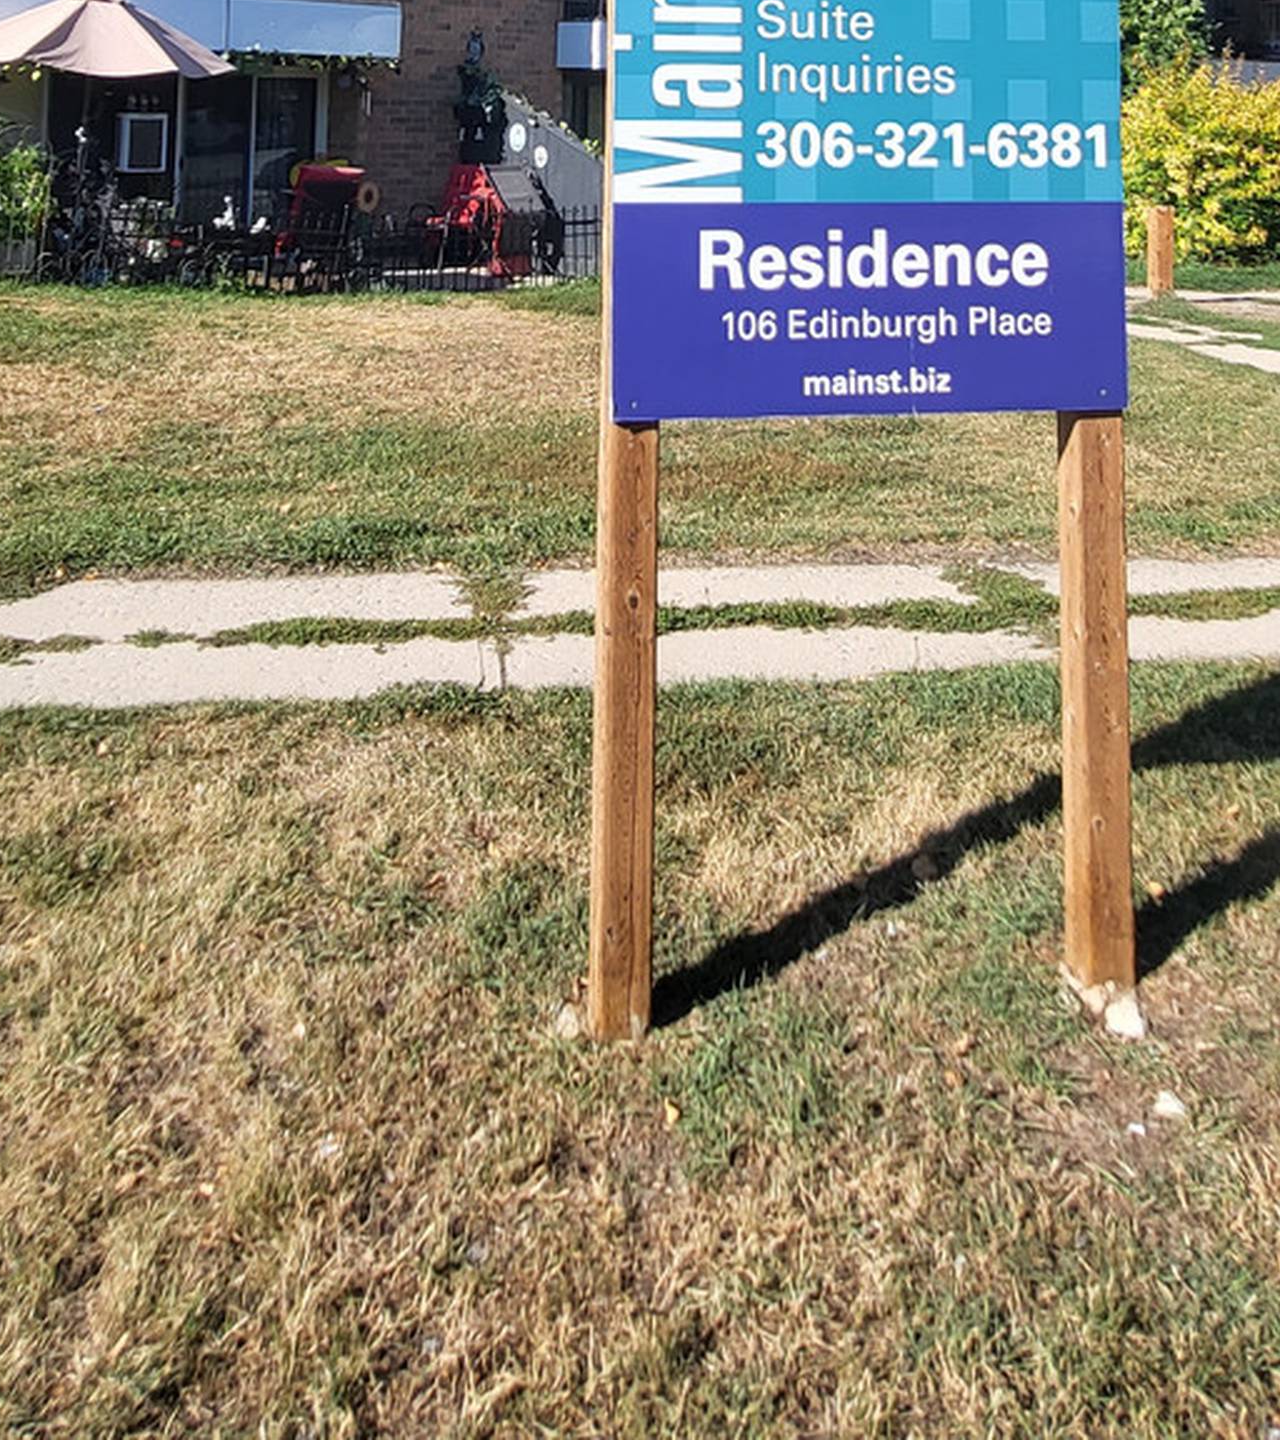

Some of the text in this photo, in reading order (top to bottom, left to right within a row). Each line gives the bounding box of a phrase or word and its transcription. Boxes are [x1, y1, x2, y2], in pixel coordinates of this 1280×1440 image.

[757, 51, 957, 103] Inquiries
[755, 120, 1108, 169] 306-321-6381
[698, 227, 1050, 291] Residence
[721, 305, 1053, 346] 106 Edinburgh Place
[802, 366, 952, 397] mainst.biz
